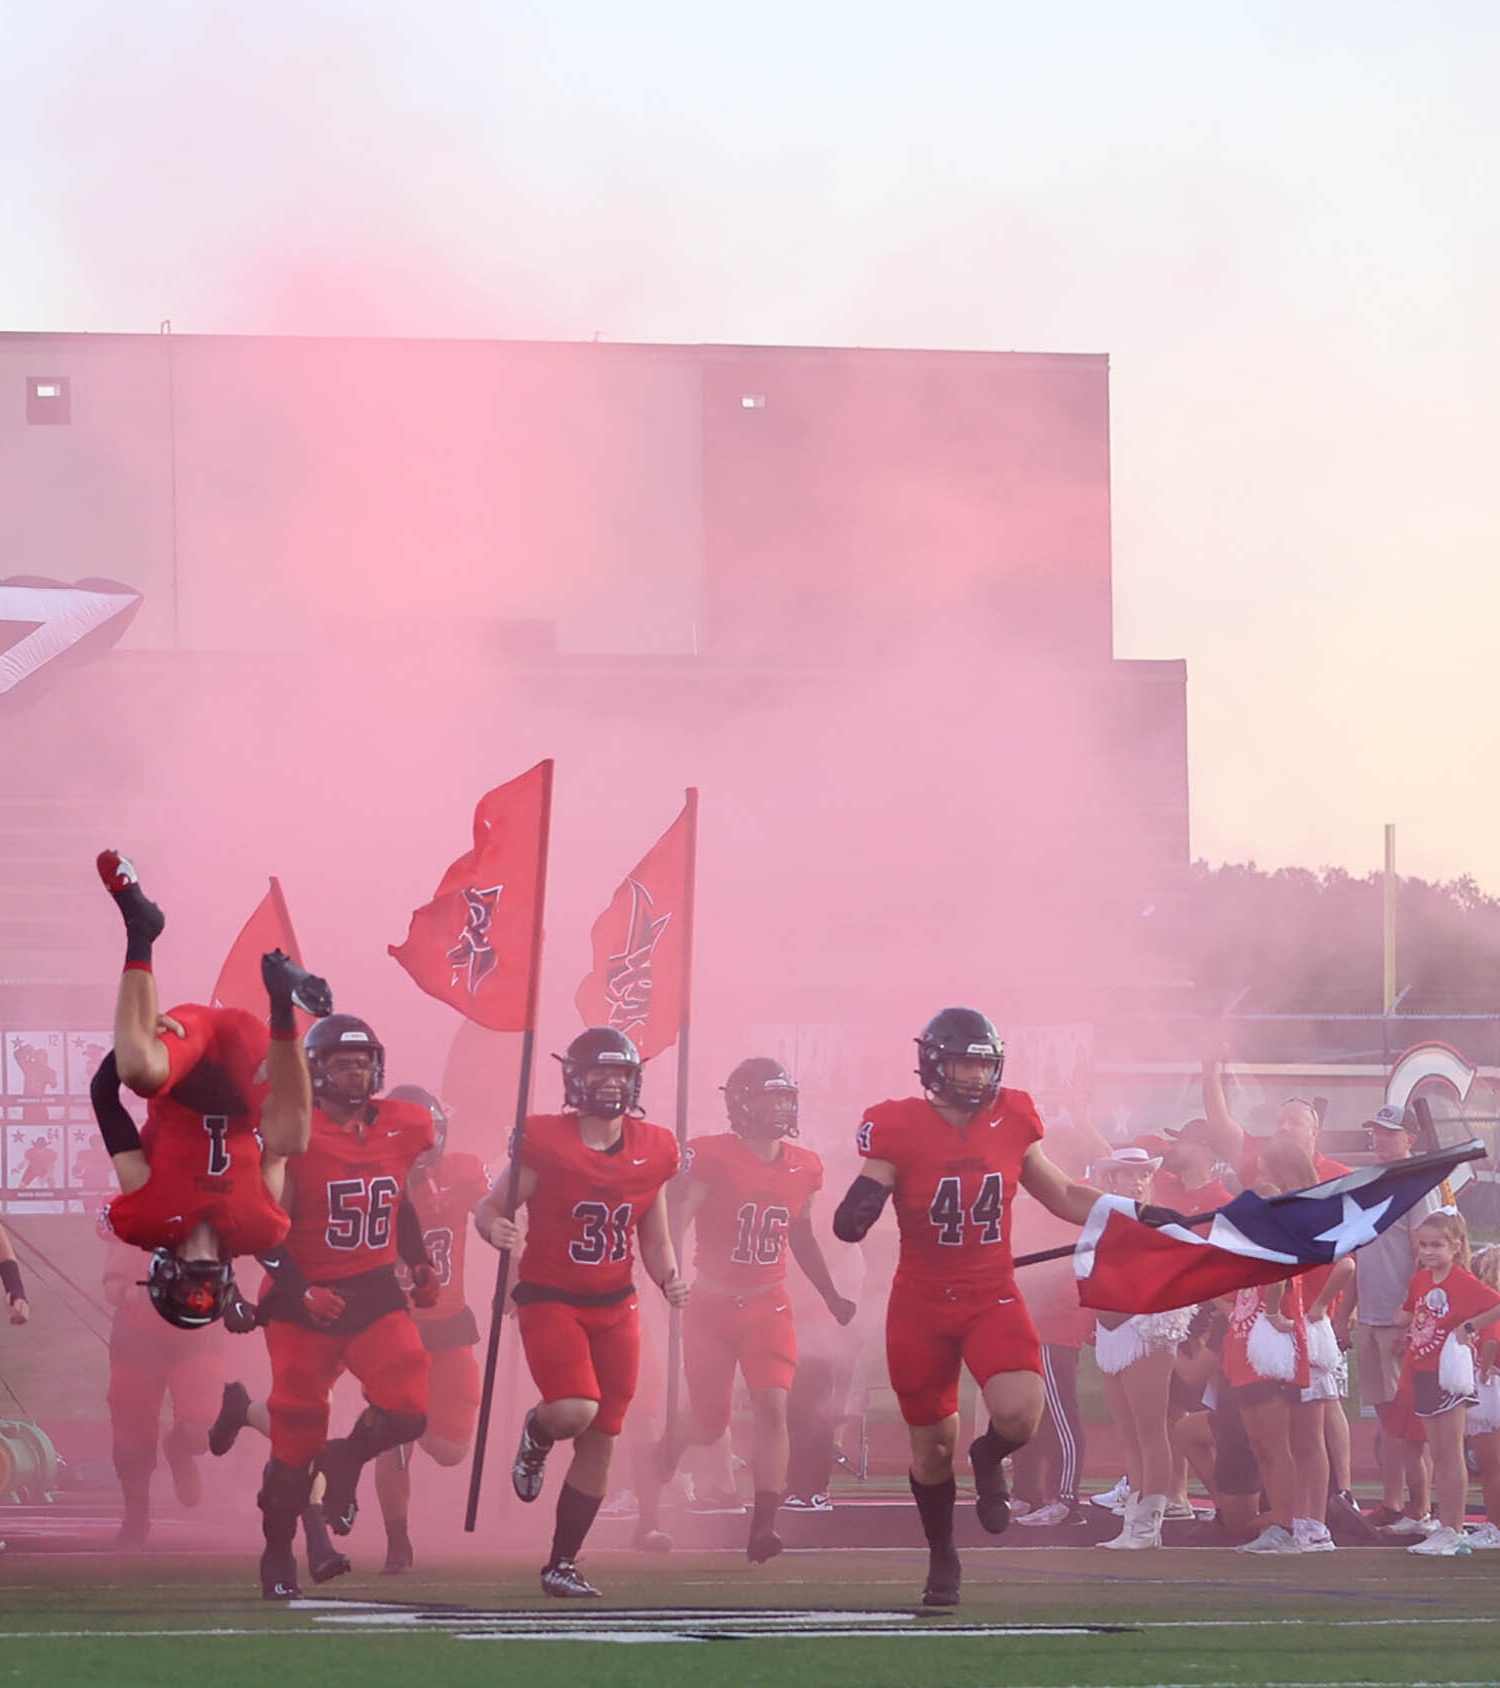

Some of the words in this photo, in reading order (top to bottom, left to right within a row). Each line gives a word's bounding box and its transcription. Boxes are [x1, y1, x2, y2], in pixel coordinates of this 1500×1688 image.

[203, 1114, 231, 1176] 1
[325, 1176, 399, 1250] 56
[569, 1201, 633, 1264] 31
[732, 1203, 789, 1264] 16
[930, 1172, 1004, 1246] 44
